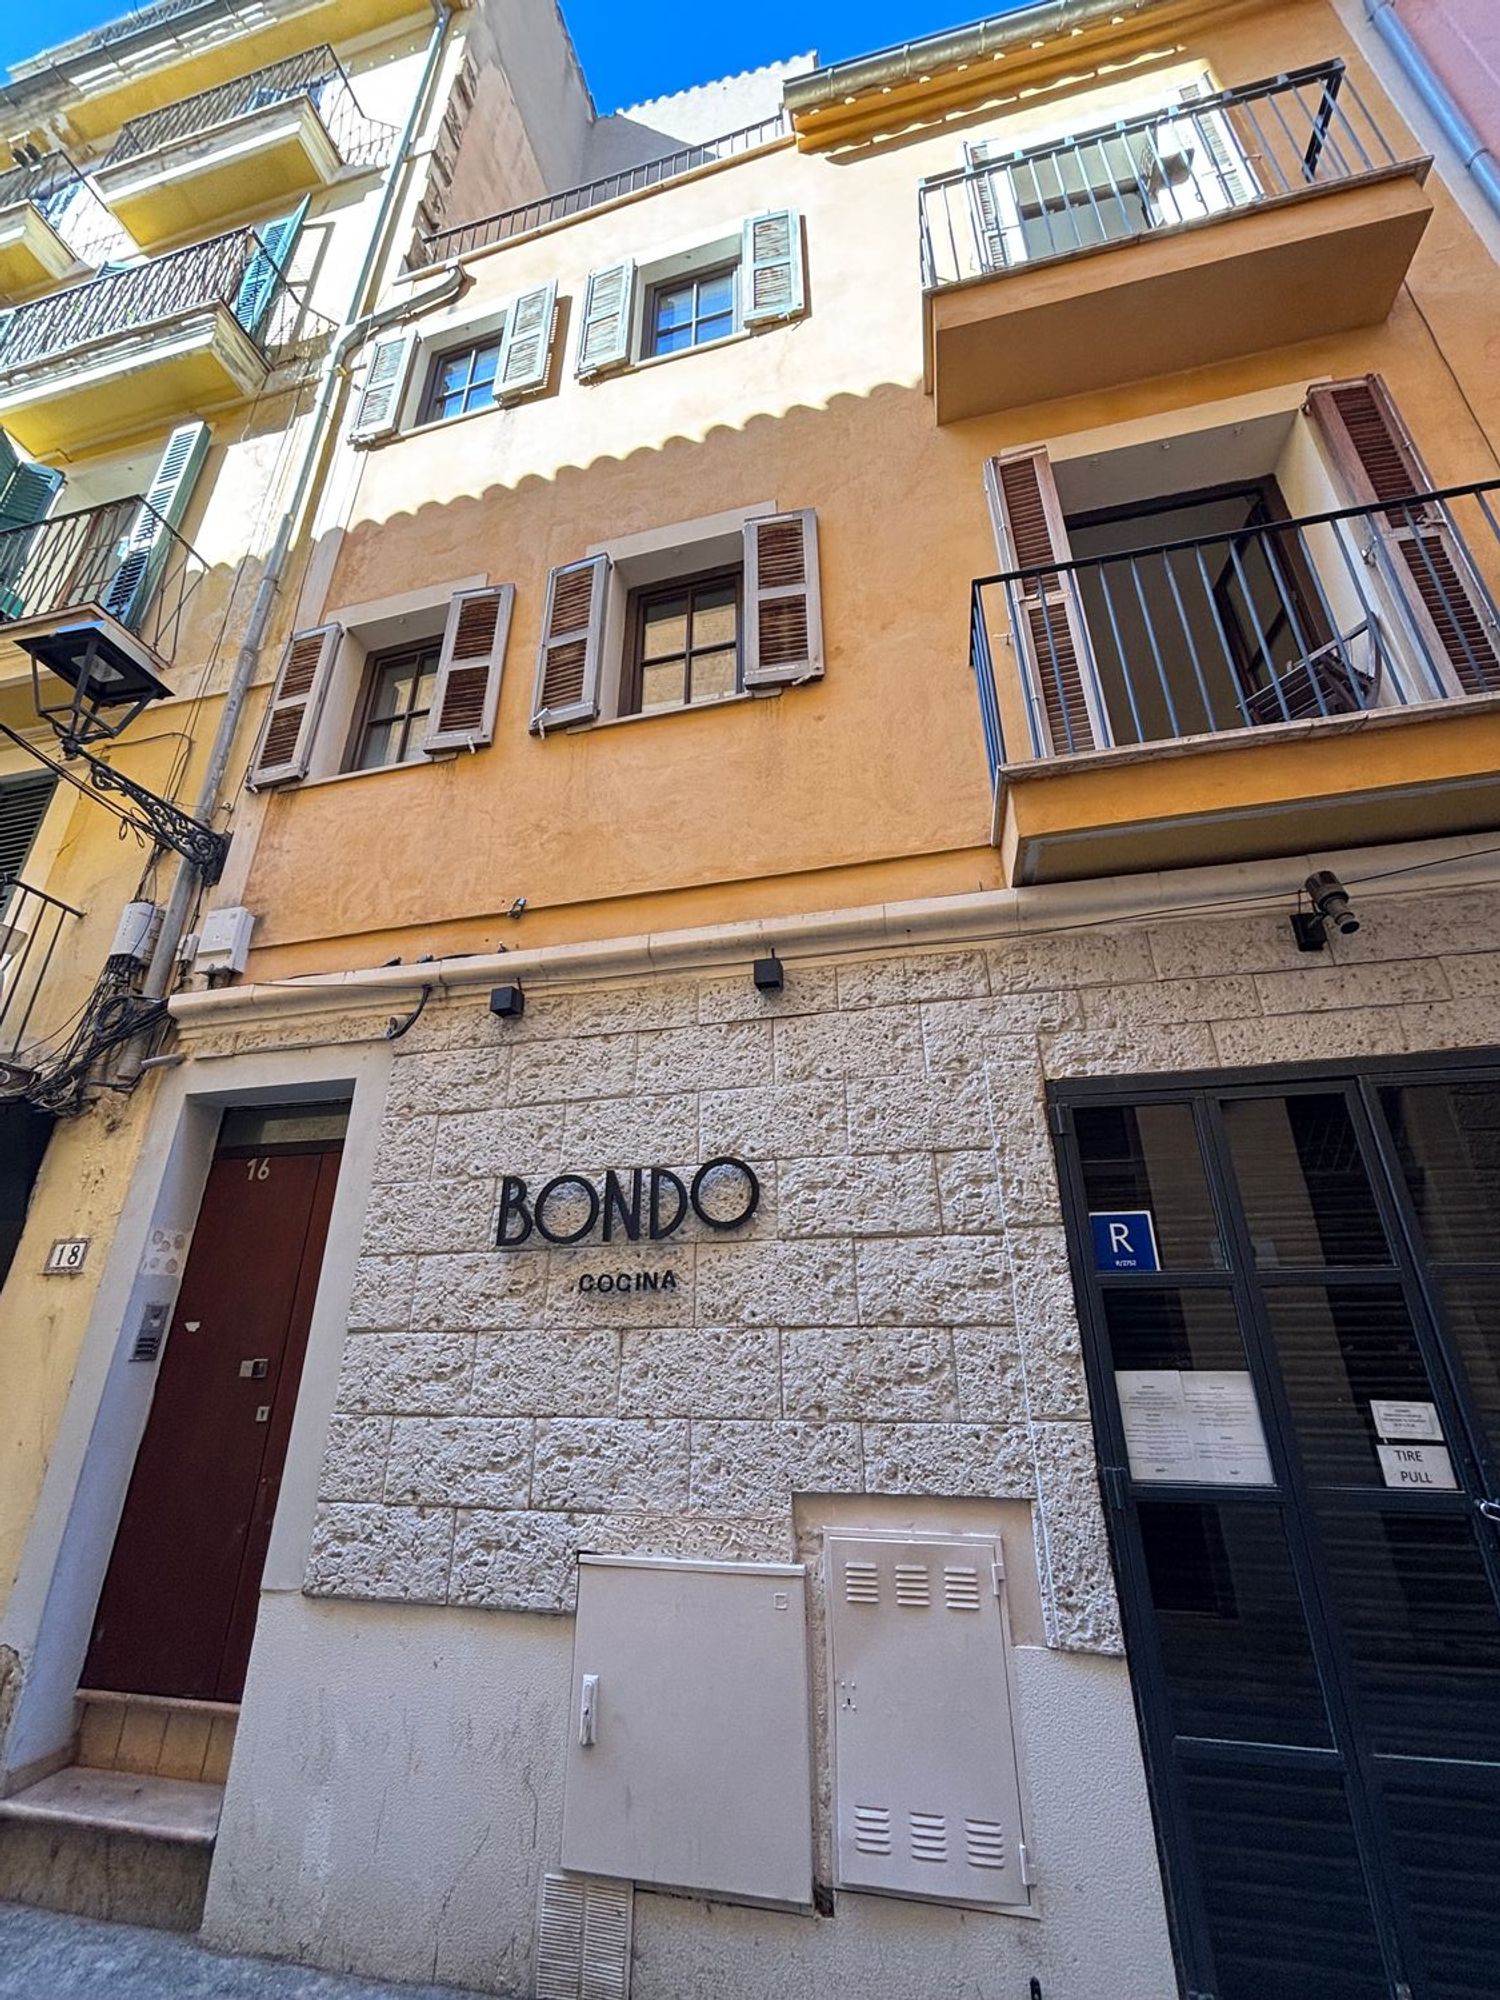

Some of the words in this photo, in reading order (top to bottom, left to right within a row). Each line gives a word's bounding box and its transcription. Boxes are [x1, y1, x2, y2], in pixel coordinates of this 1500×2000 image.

[246, 1157, 270, 1181] 16
[496, 1156, 760, 1247] BONDO
[1109, 1222, 1135, 1253] R
[55, 1245, 81, 1266] 18
[578, 1269, 677, 1293] COCINA
[1394, 1450, 1423, 1463] TIRE
[1400, 1471, 1433, 1484] PULL
